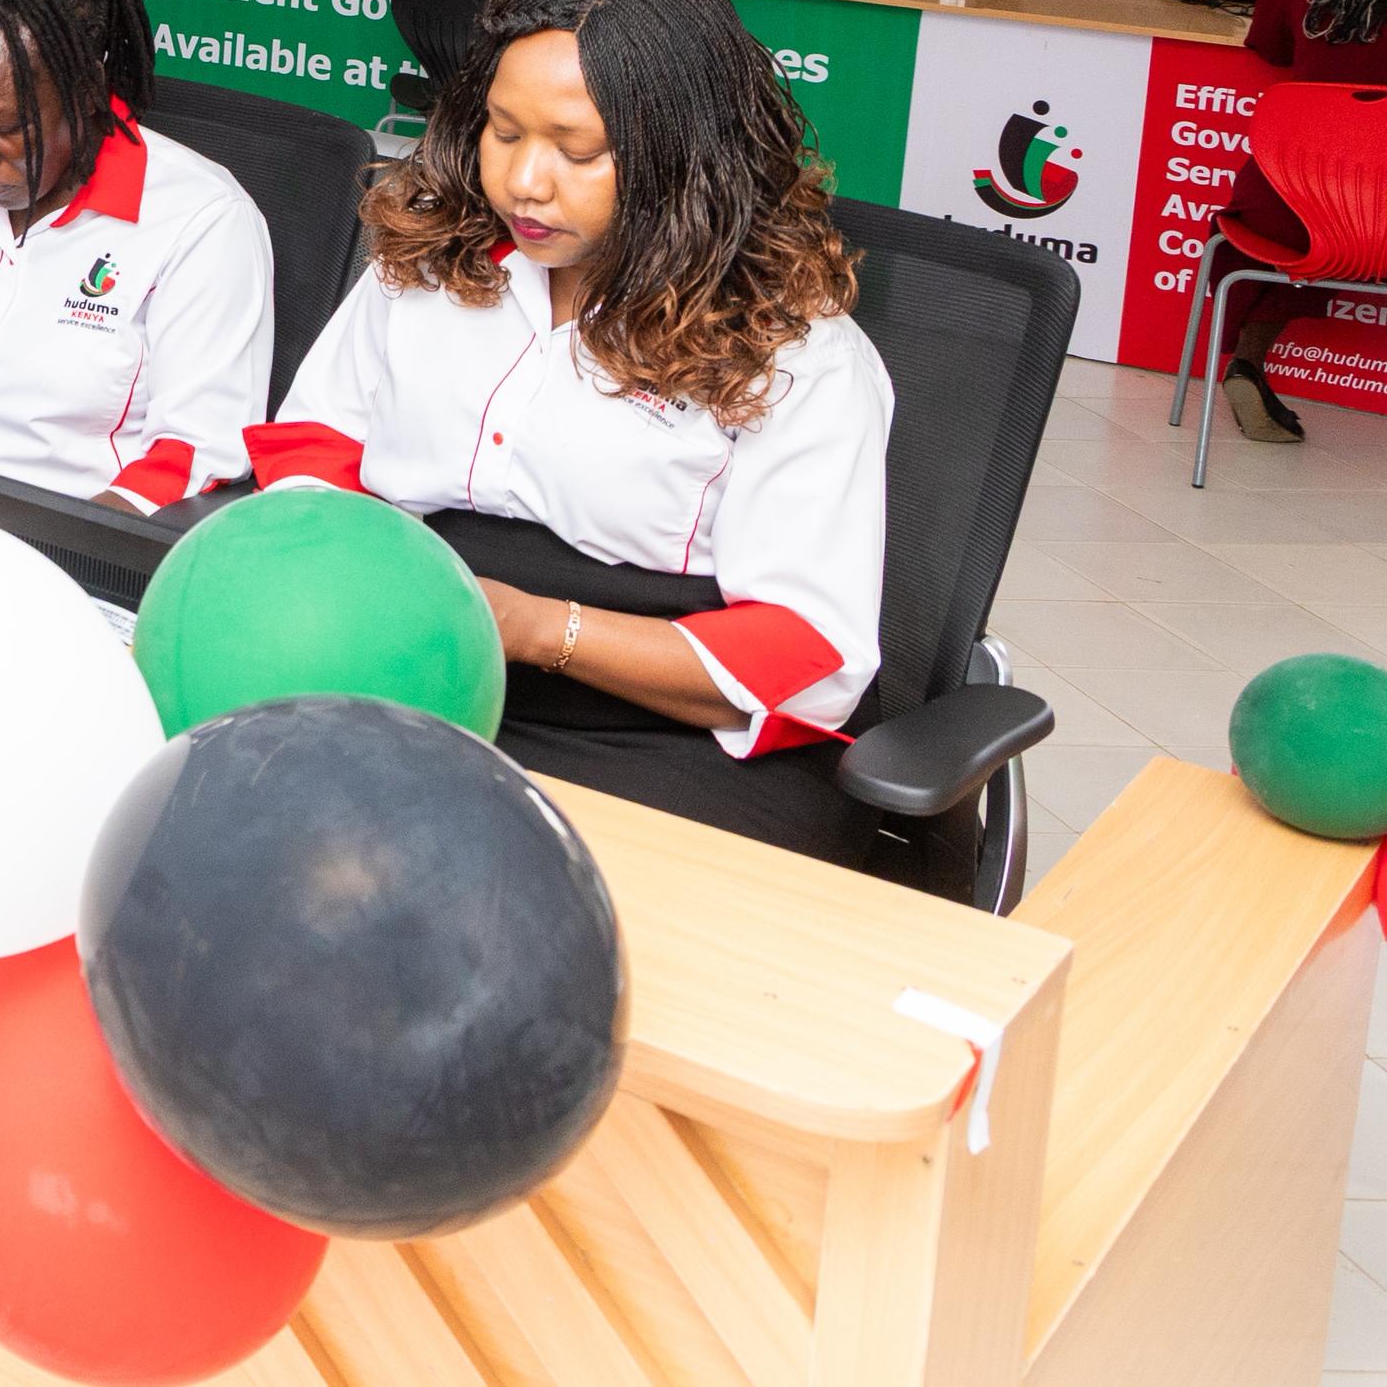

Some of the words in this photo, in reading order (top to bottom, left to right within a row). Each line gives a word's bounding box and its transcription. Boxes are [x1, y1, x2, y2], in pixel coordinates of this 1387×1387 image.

[153, 23, 332, 81] Available
[343, 56, 387, 89] at
[1176, 83, 1263, 117] Effic
[1154, 268, 1193, 293] of
[63, 297, 119, 316] huduma
[71, 310, 105, 323] KENYA
